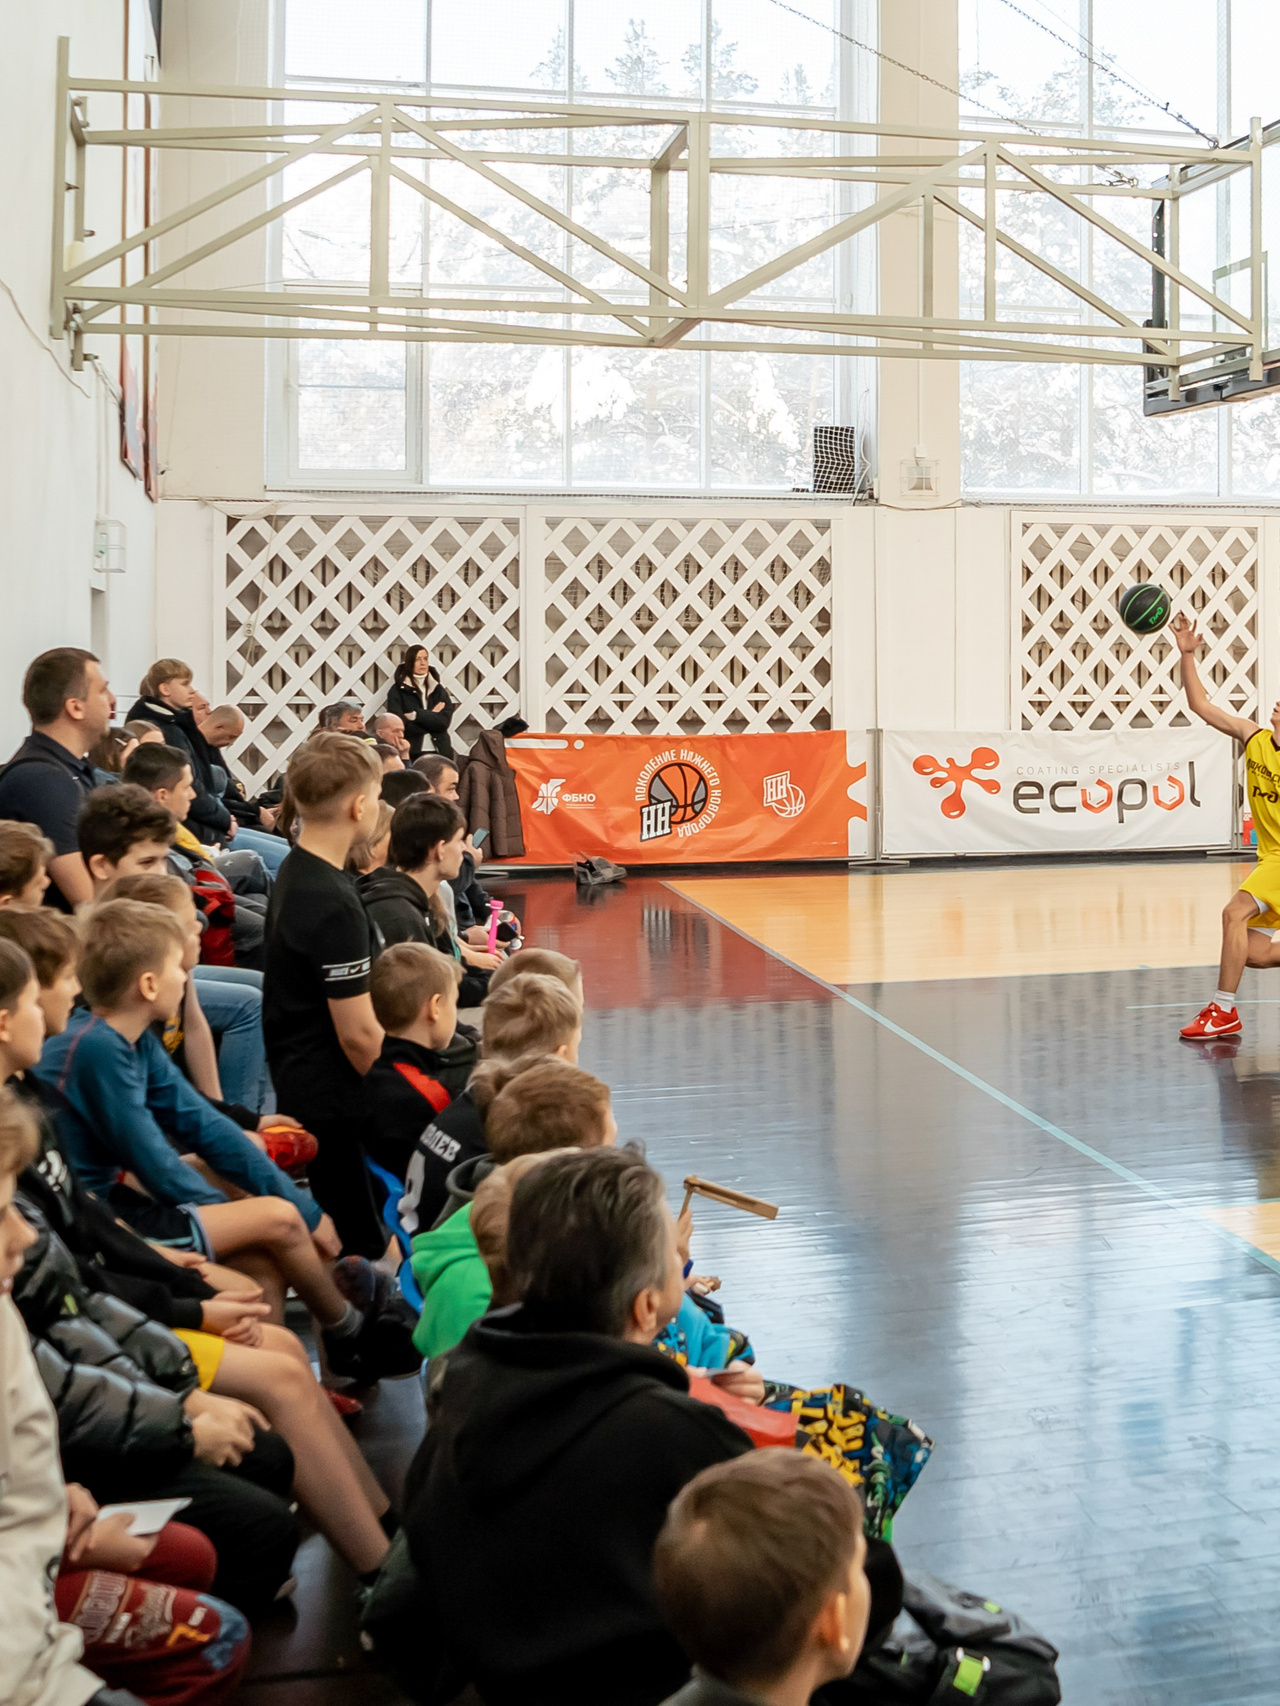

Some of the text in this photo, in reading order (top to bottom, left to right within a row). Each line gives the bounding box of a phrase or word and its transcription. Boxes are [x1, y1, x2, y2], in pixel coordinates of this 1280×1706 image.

[1016, 761, 1181, 776] COATING SPECIALISTS
[561, 793, 596, 803] ФБНО
[635, 749, 722, 838] ПОКОЛЕНИЕ НИЖНЕГО НОВГОРОДА
[1012, 760, 1201, 823] ecopol
